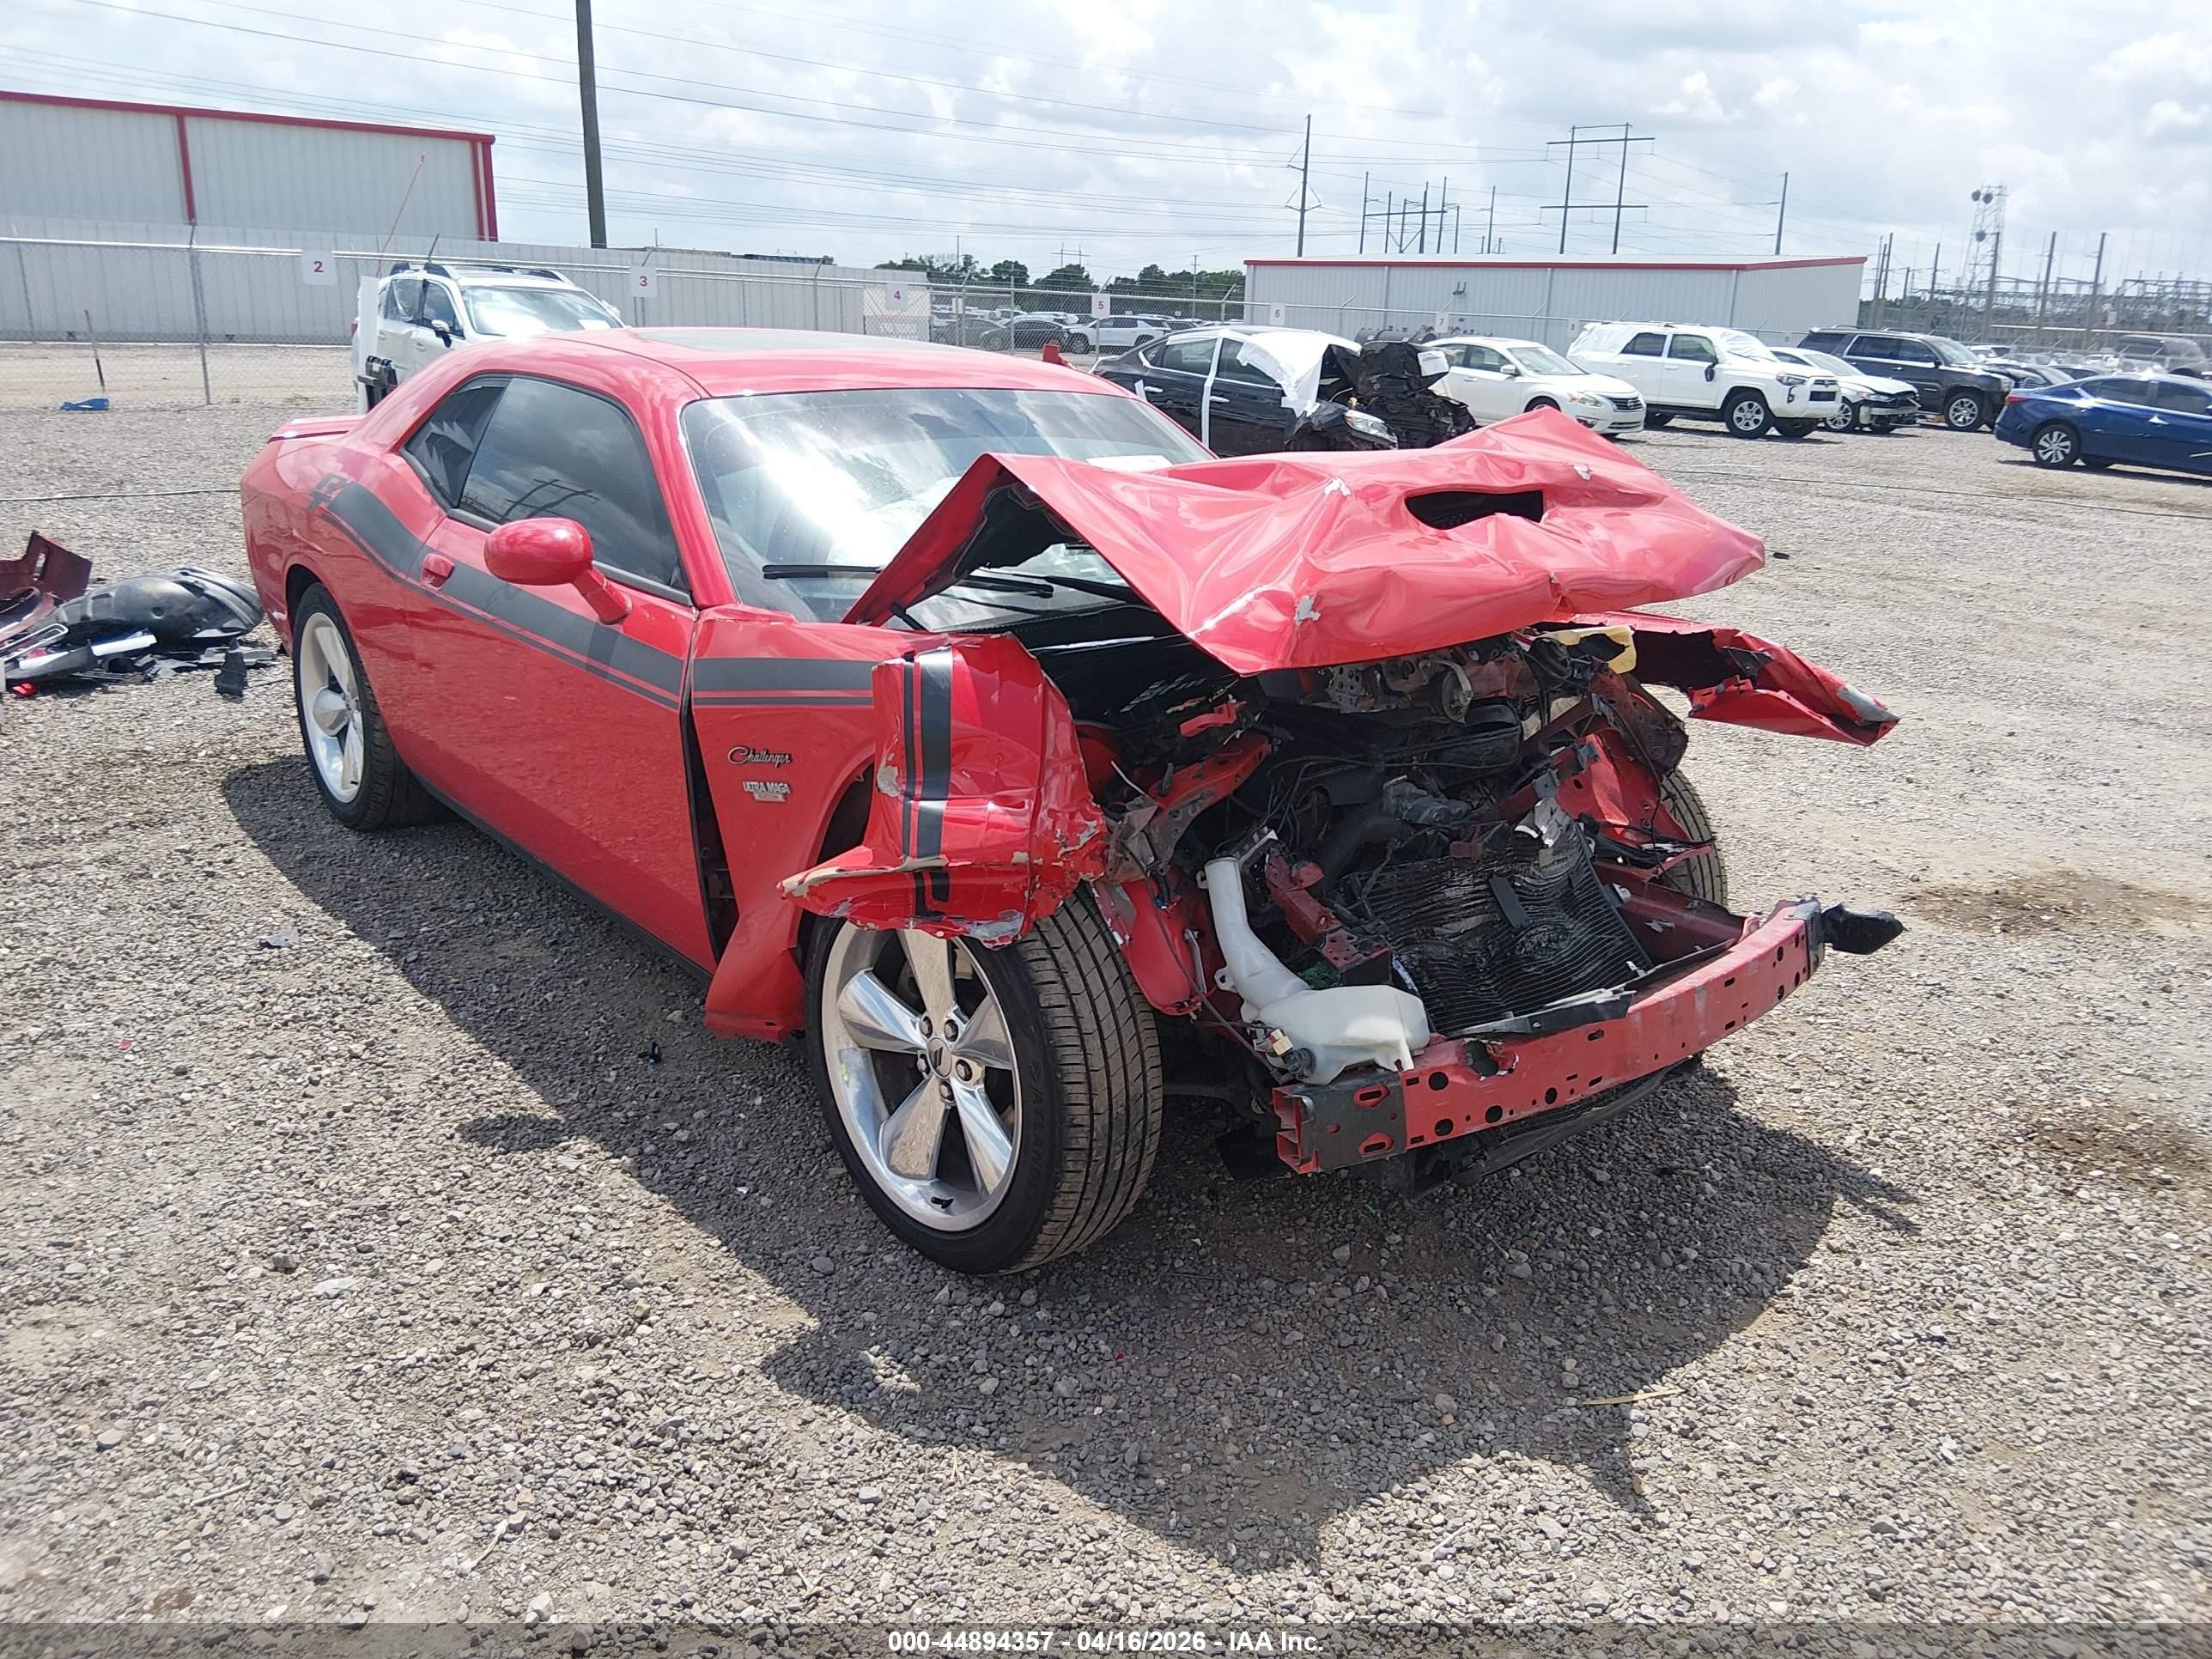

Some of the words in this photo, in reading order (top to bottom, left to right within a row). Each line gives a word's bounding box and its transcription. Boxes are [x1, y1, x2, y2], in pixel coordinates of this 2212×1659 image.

[313, 260, 324, 273] 2
[639, 276, 647, 287] 3
[893, 290, 902, 301] 4
[1098, 301, 1104, 310] 5
[1275, 309, 1280, 318] 6
[727, 745, 792, 769] Challenger
[742, 781, 767, 793] ULTRA
[767, 781, 791, 794] MAGA
